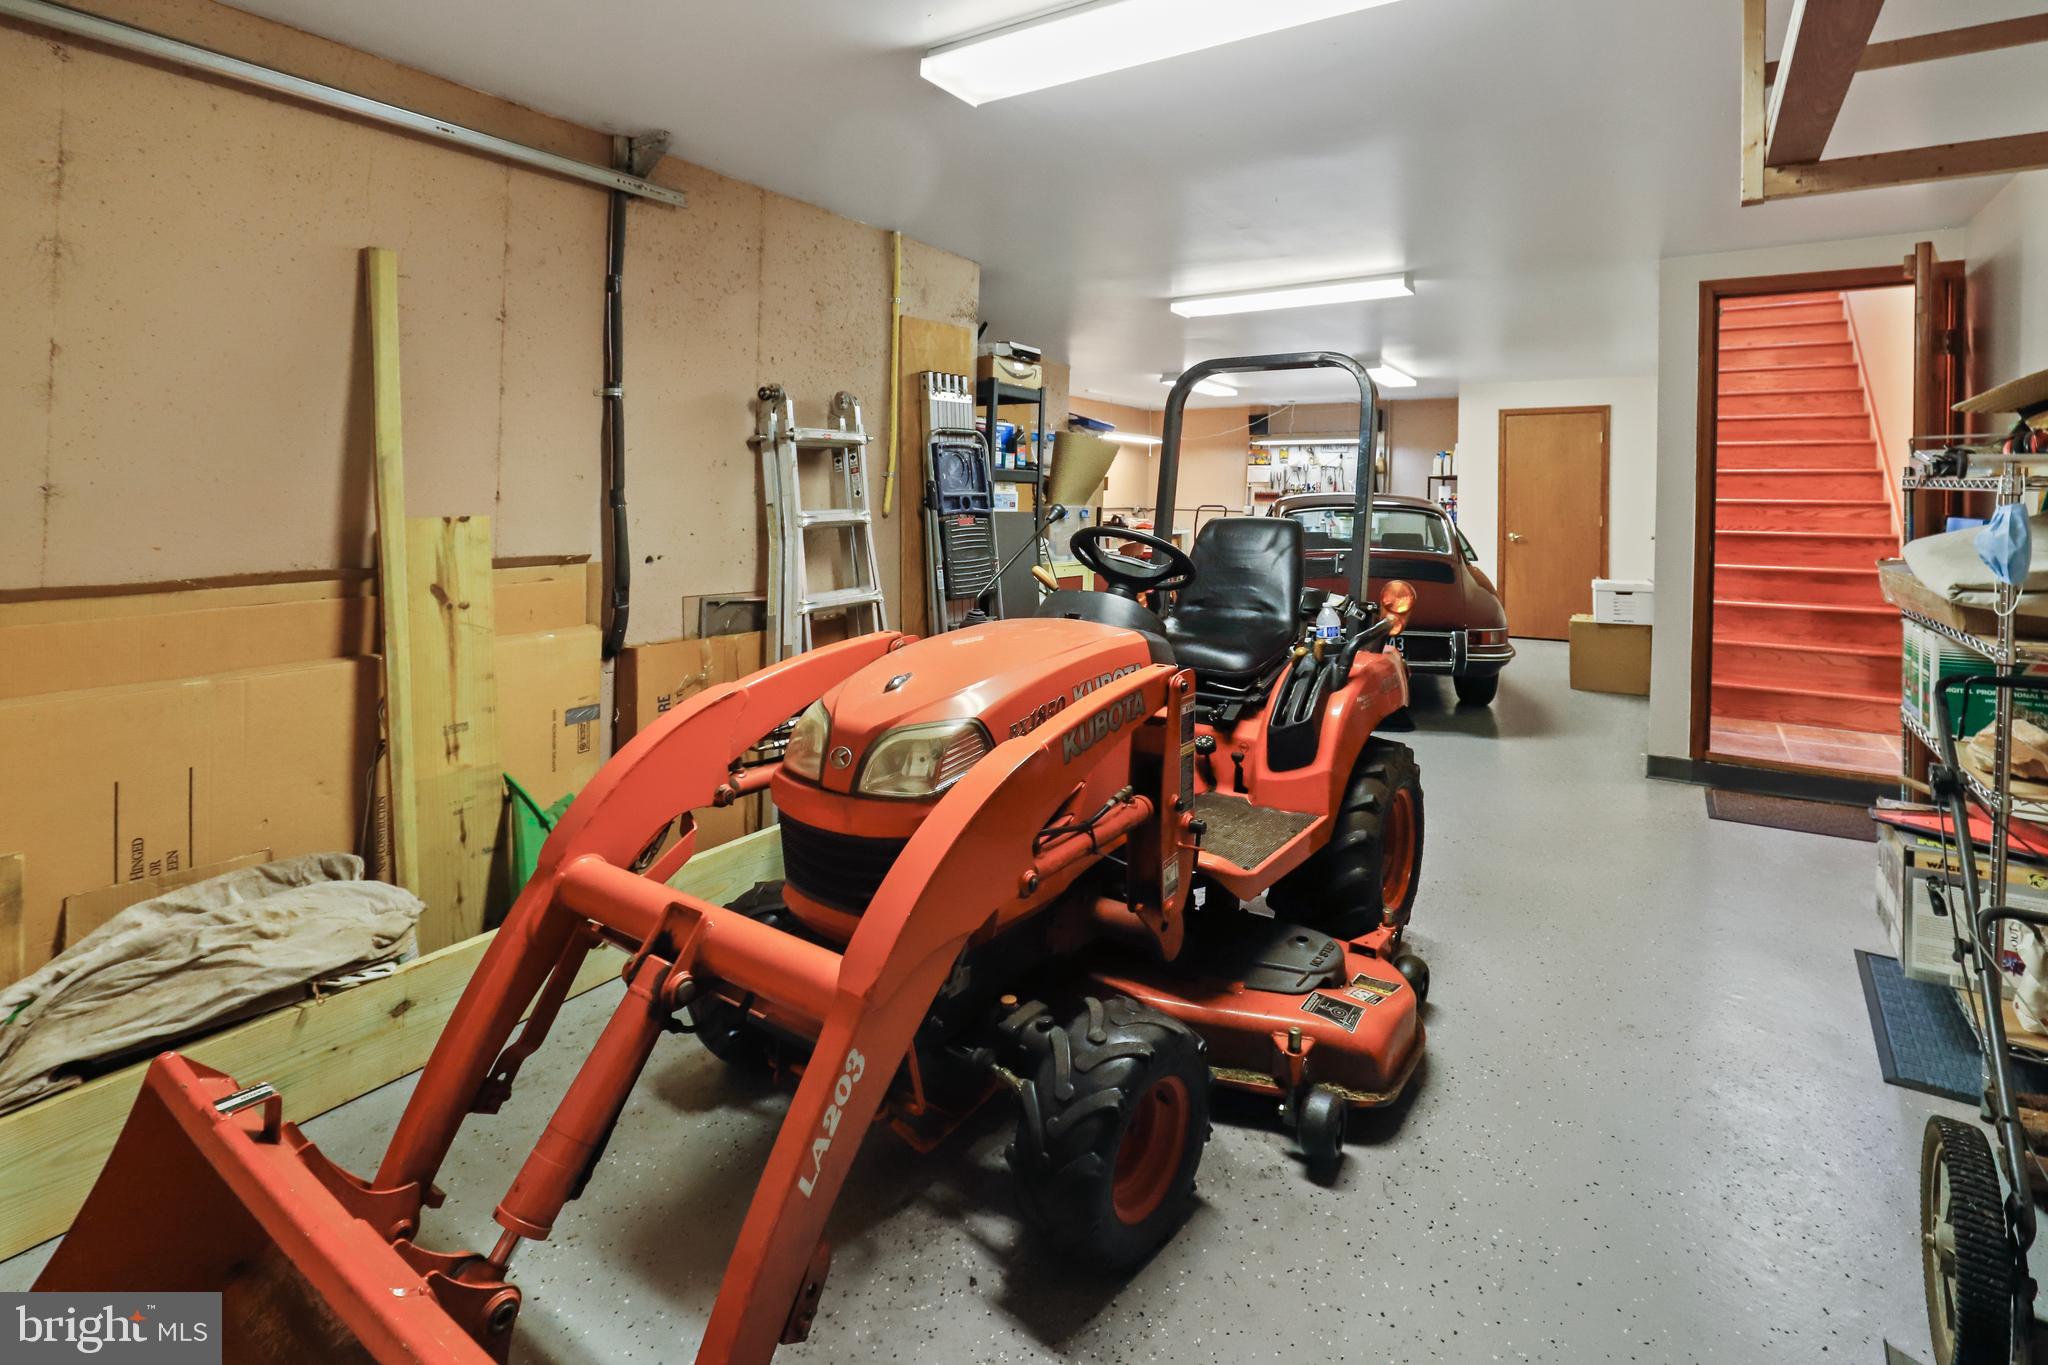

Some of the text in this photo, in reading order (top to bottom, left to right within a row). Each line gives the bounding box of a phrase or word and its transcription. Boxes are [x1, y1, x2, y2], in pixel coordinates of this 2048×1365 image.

[1072, 663, 1142, 702] KUBOT
[1945, 686, 1973, 696] IGITL
[1062, 688, 1146, 765] KUBOTA
[129, 837, 144, 881] HINGED
[149, 859, 161, 876] OR
[1926, 857, 1984, 877] WAGR
[798, 1048, 865, 1198] LA203
